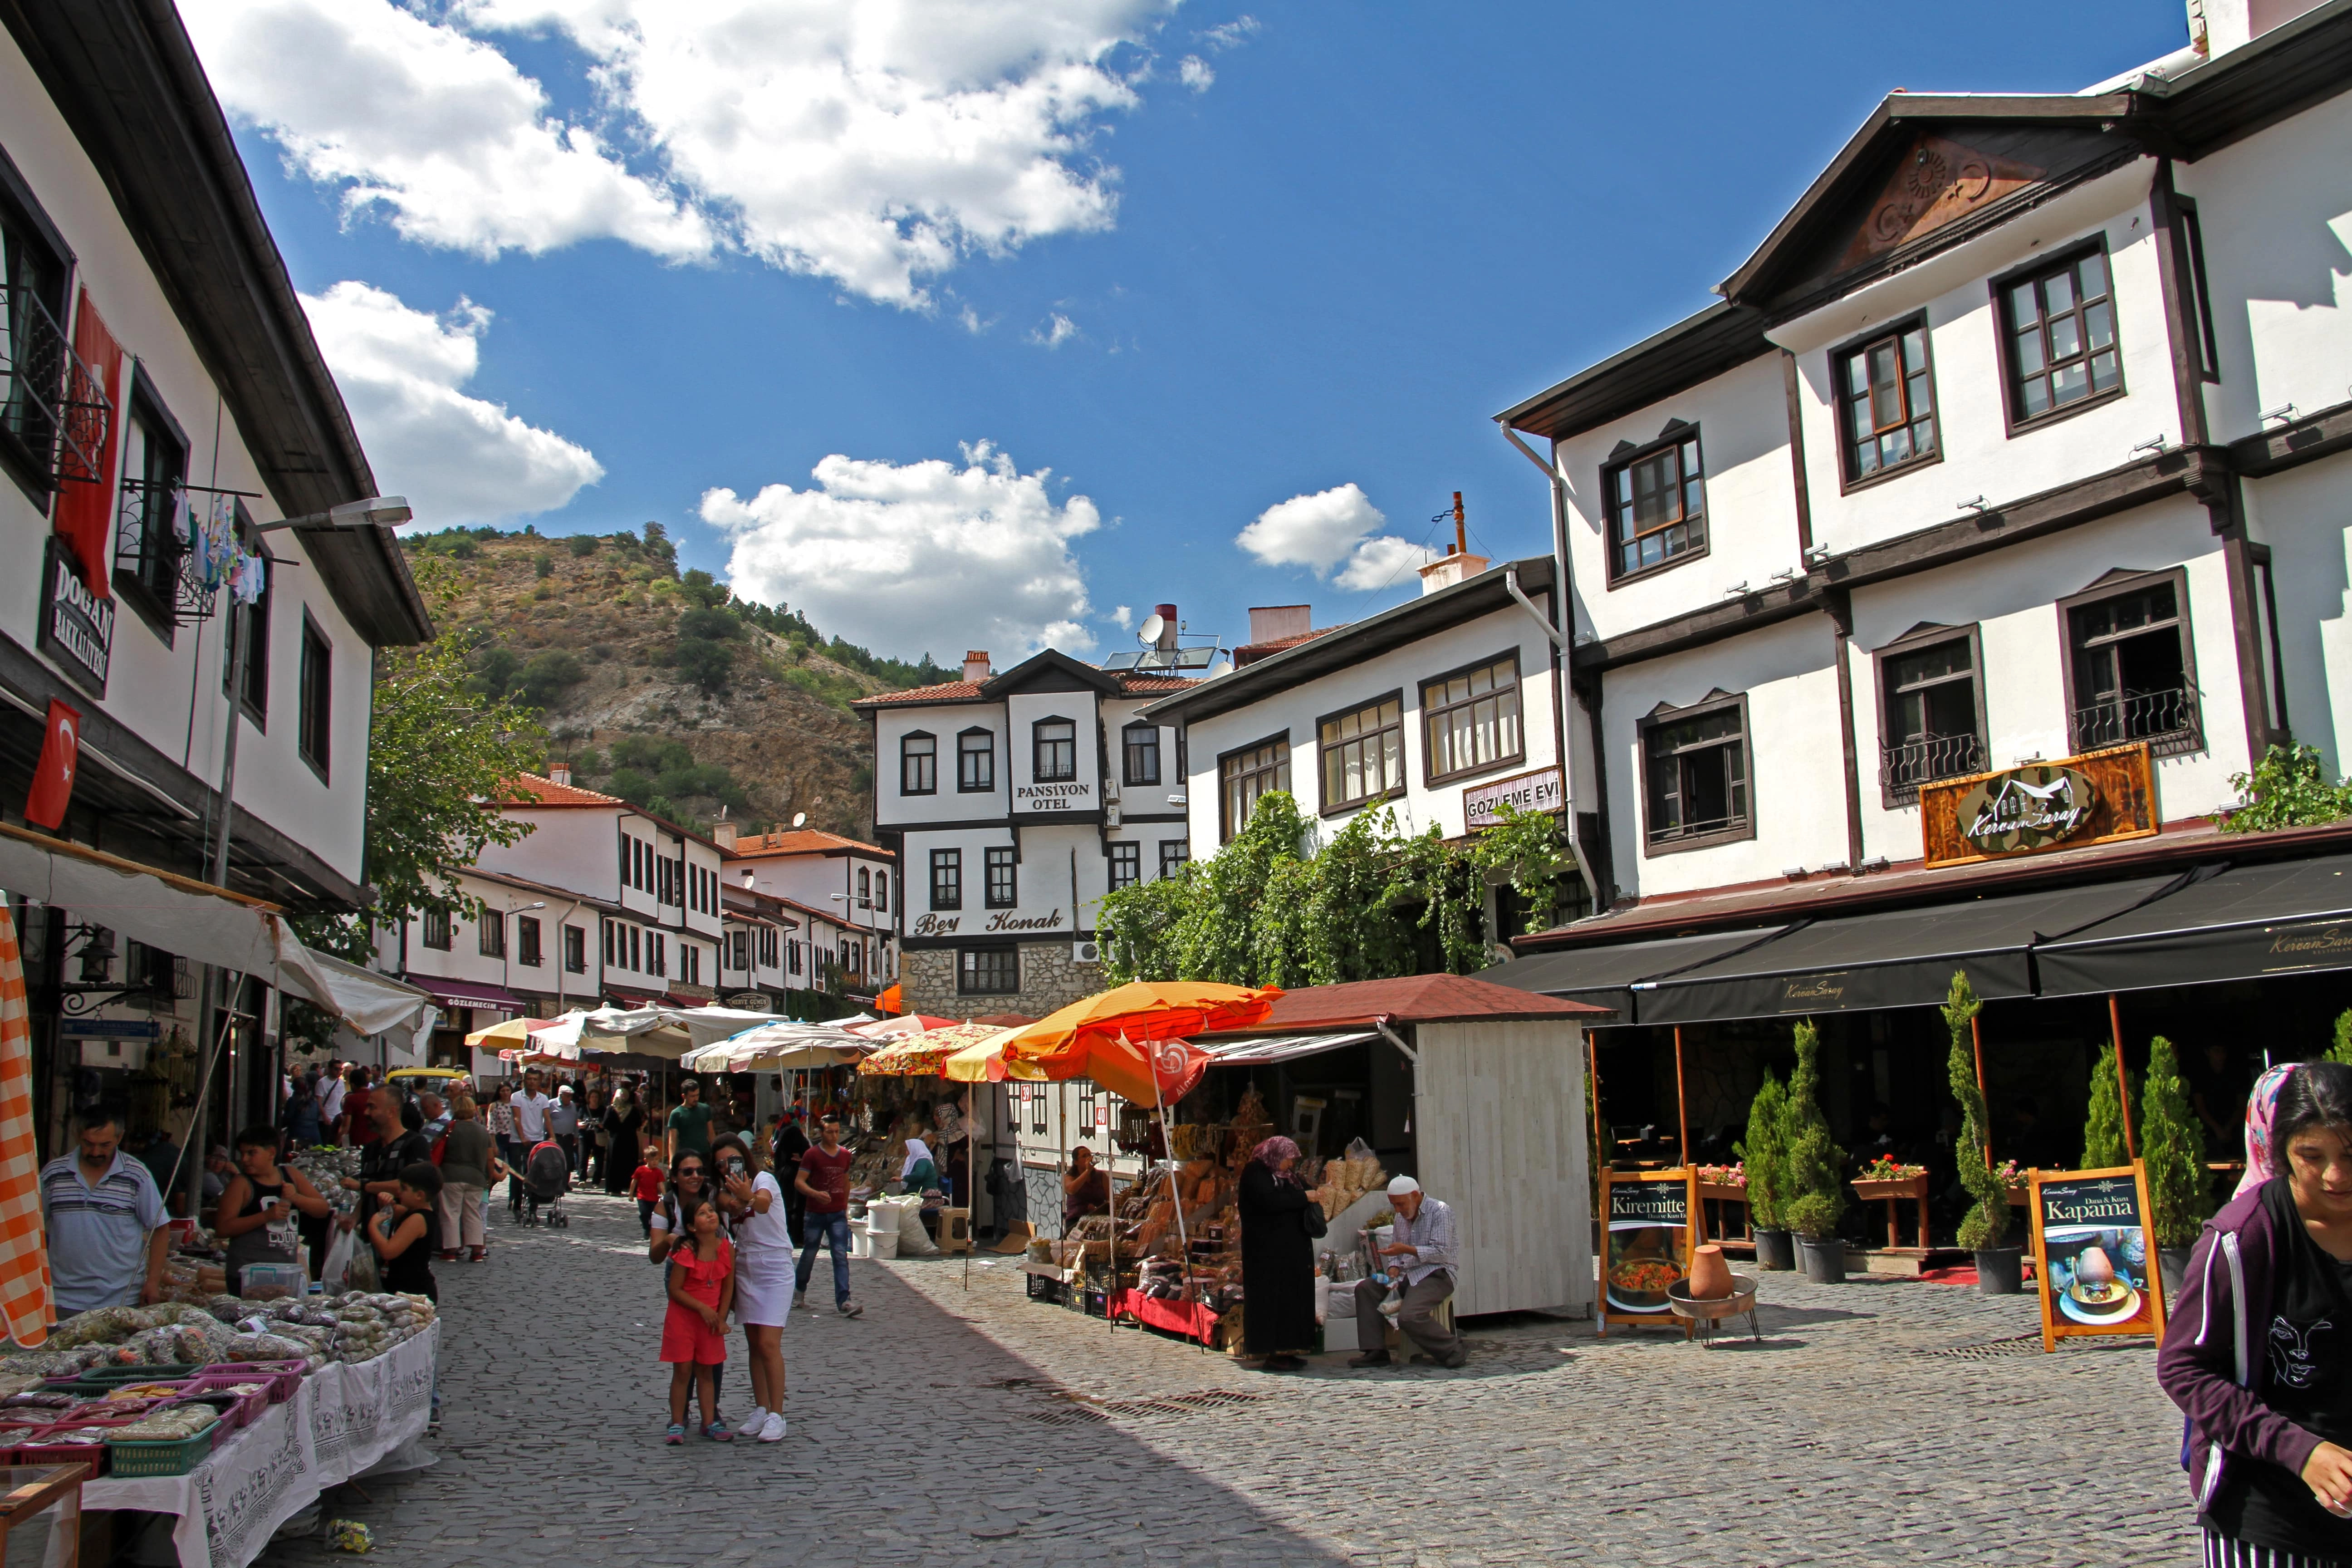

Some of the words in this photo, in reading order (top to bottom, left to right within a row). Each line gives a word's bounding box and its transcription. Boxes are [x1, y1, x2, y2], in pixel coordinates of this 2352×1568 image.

[1017, 784, 1089, 797] PANSİYON
[1468, 789, 1531, 817] GÖZLEME
[1536, 778, 1559, 801] EVİ
[1033, 799, 1071, 809] OTEL
[914, 913, 960, 936] Bey
[985, 908, 1063, 931] Konak
[1023, 1086, 1029, 1100] 39
[1097, 1108, 1105, 1123] 40
[1612, 1196, 1685, 1213] Kiremitte
[2045, 1201, 2134, 1223] Kapama
